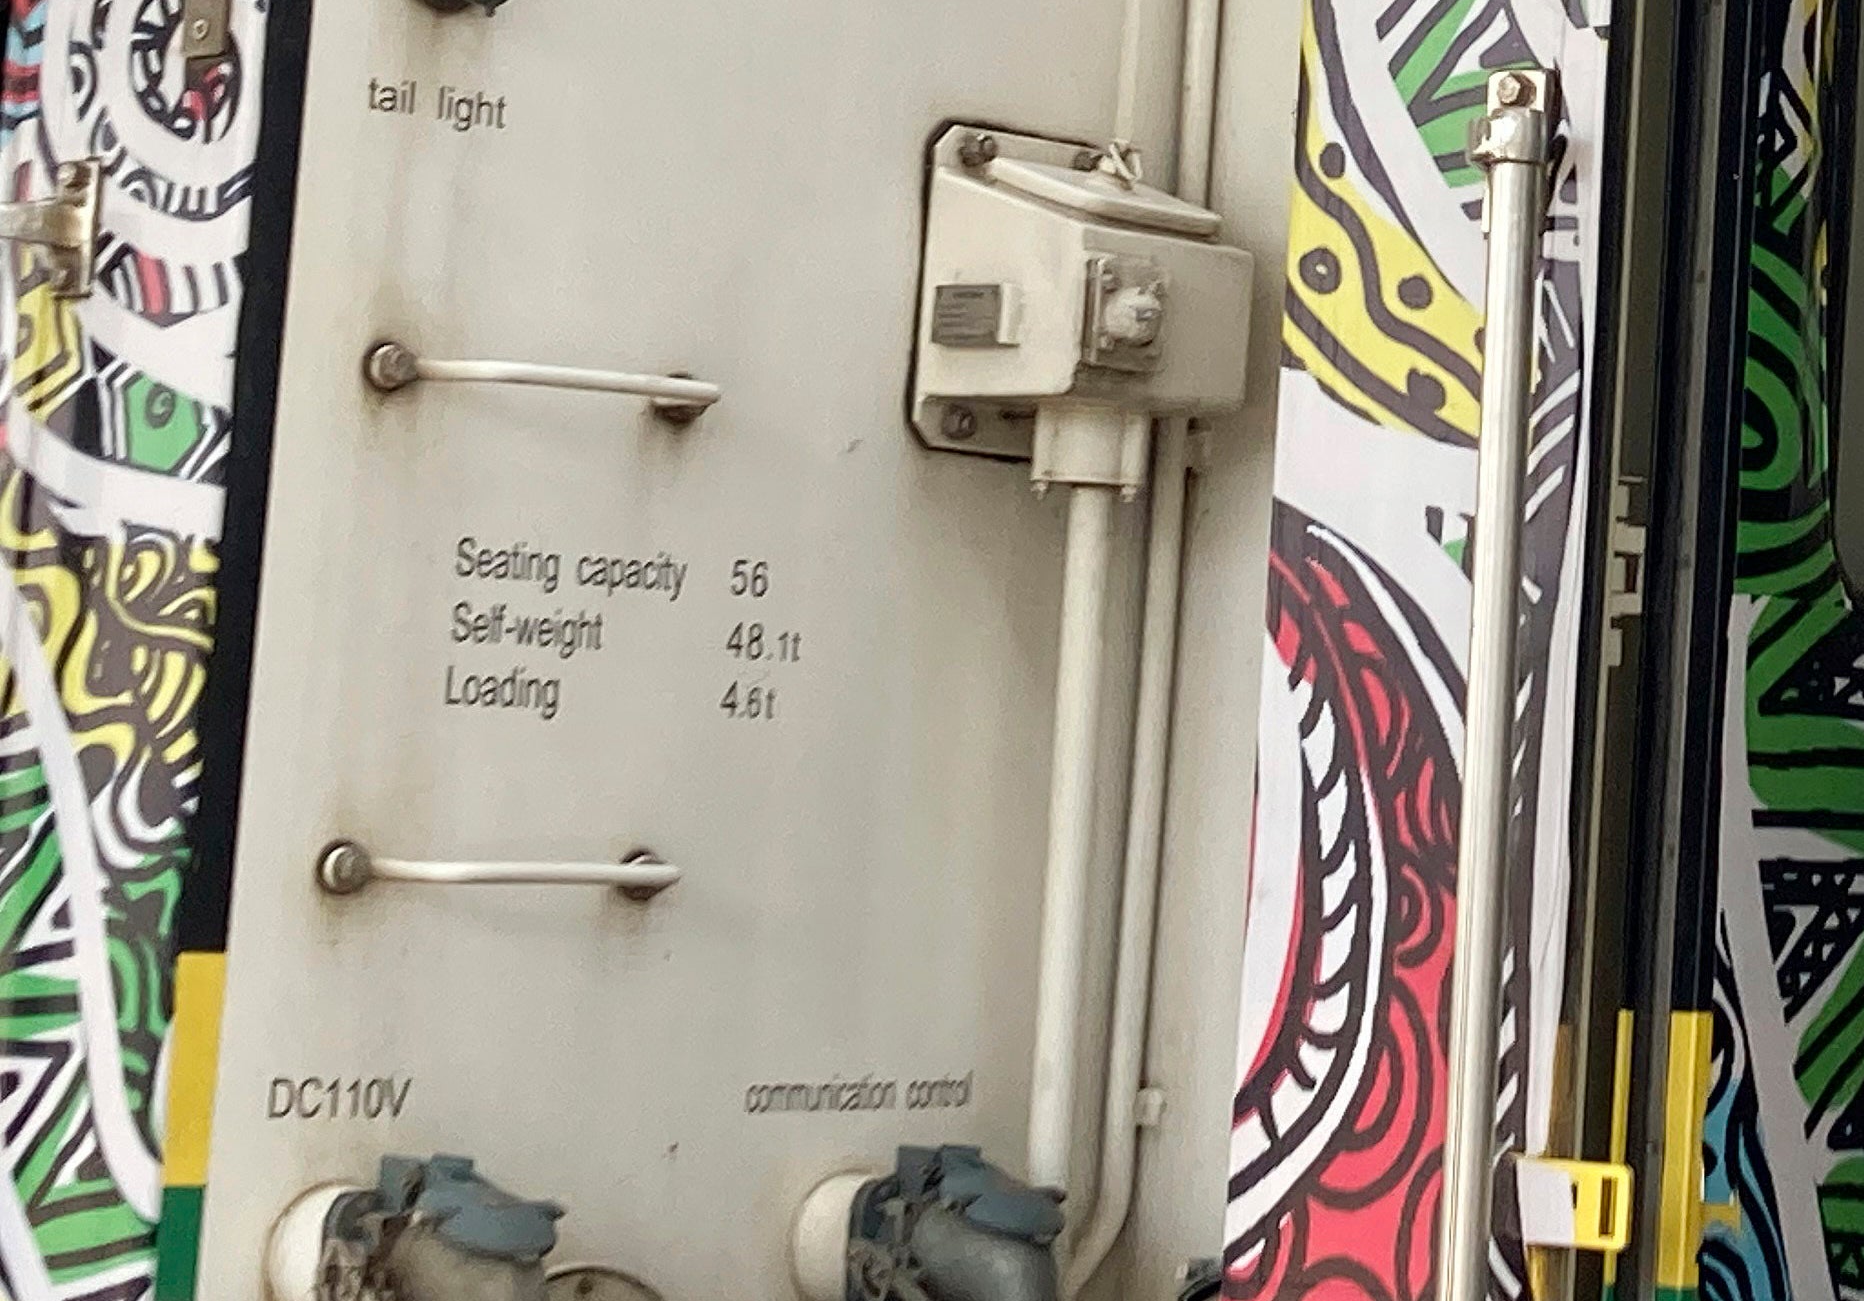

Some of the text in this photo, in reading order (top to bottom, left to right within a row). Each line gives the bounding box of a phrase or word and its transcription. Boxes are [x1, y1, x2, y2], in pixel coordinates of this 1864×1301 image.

[368, 77, 507, 132] tail light
[455, 537, 769, 601] Seating capacity 56
[451, 601, 801, 662] Self-weight 48.1t
[445, 665, 776, 720] Loading 4.6t
[267, 1076, 413, 1120] DC110V
[744, 1070, 973, 1113] communication control
